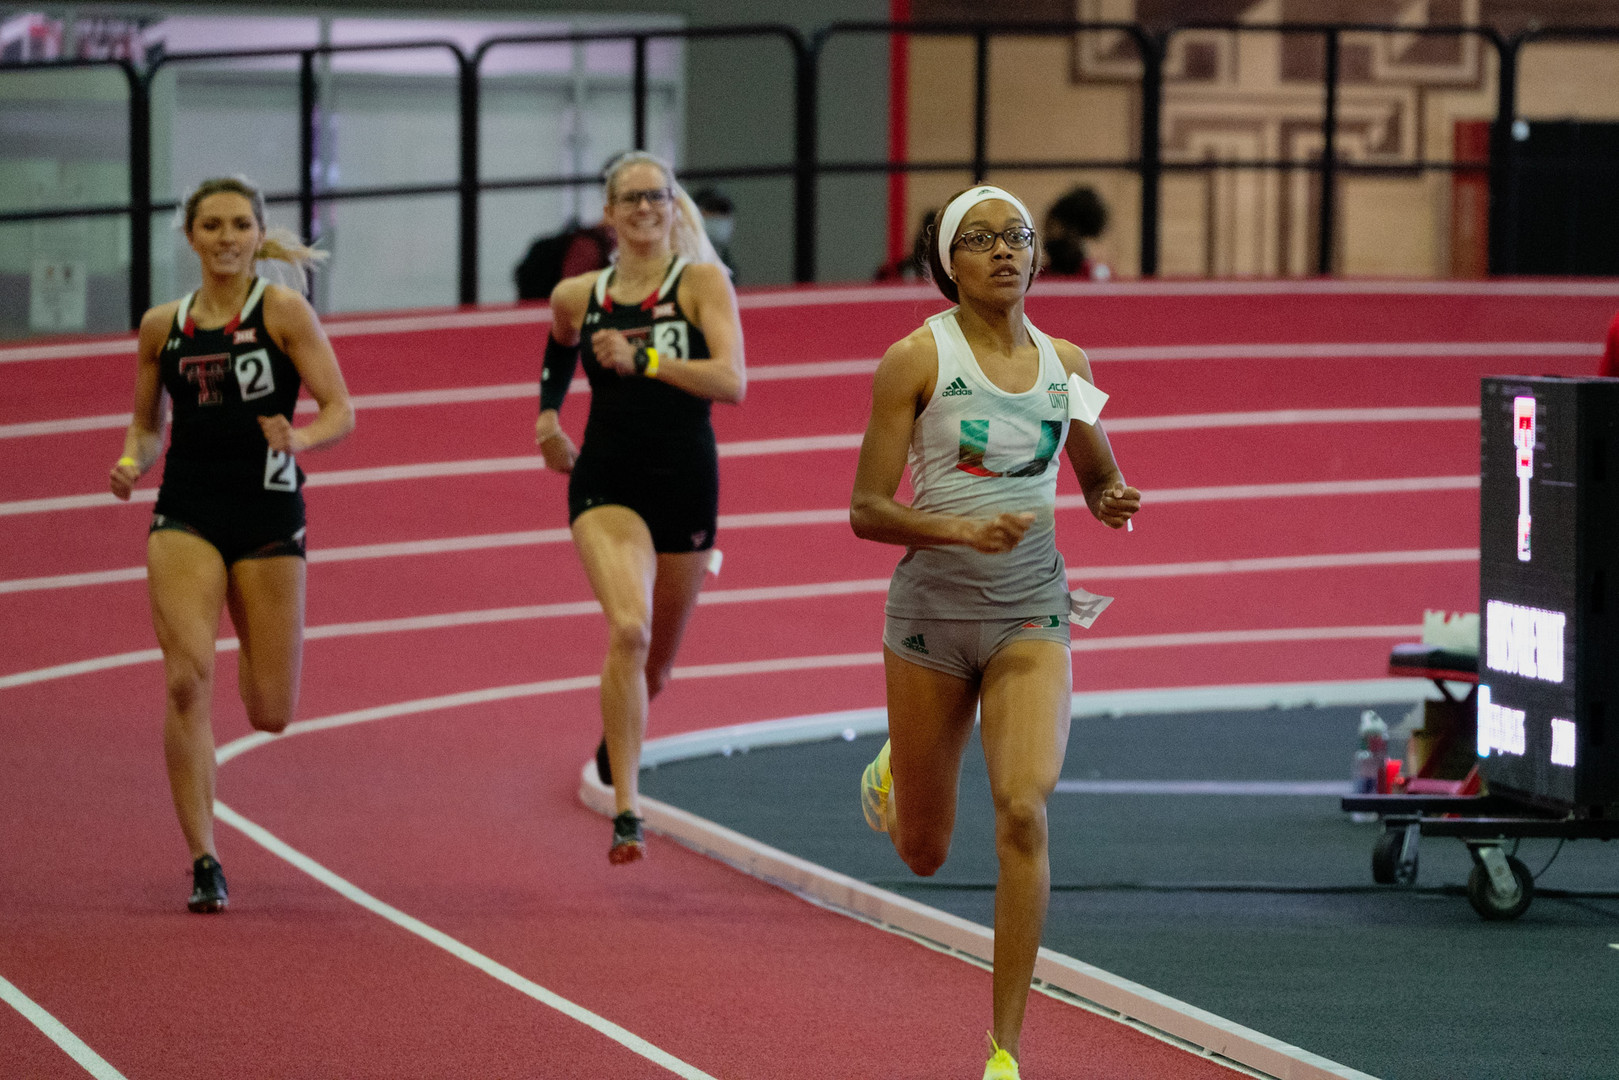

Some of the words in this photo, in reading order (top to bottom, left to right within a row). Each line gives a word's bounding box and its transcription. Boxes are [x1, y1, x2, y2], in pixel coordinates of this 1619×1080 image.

[661, 326, 683, 359] 3
[239, 357, 269, 395] 2
[1047, 382, 1069, 392] ACC
[941, 388, 973, 398] adidas
[956, 419, 1063, 478] U
[269, 449, 291, 486] 2
[1070, 598, 1104, 621] 4
